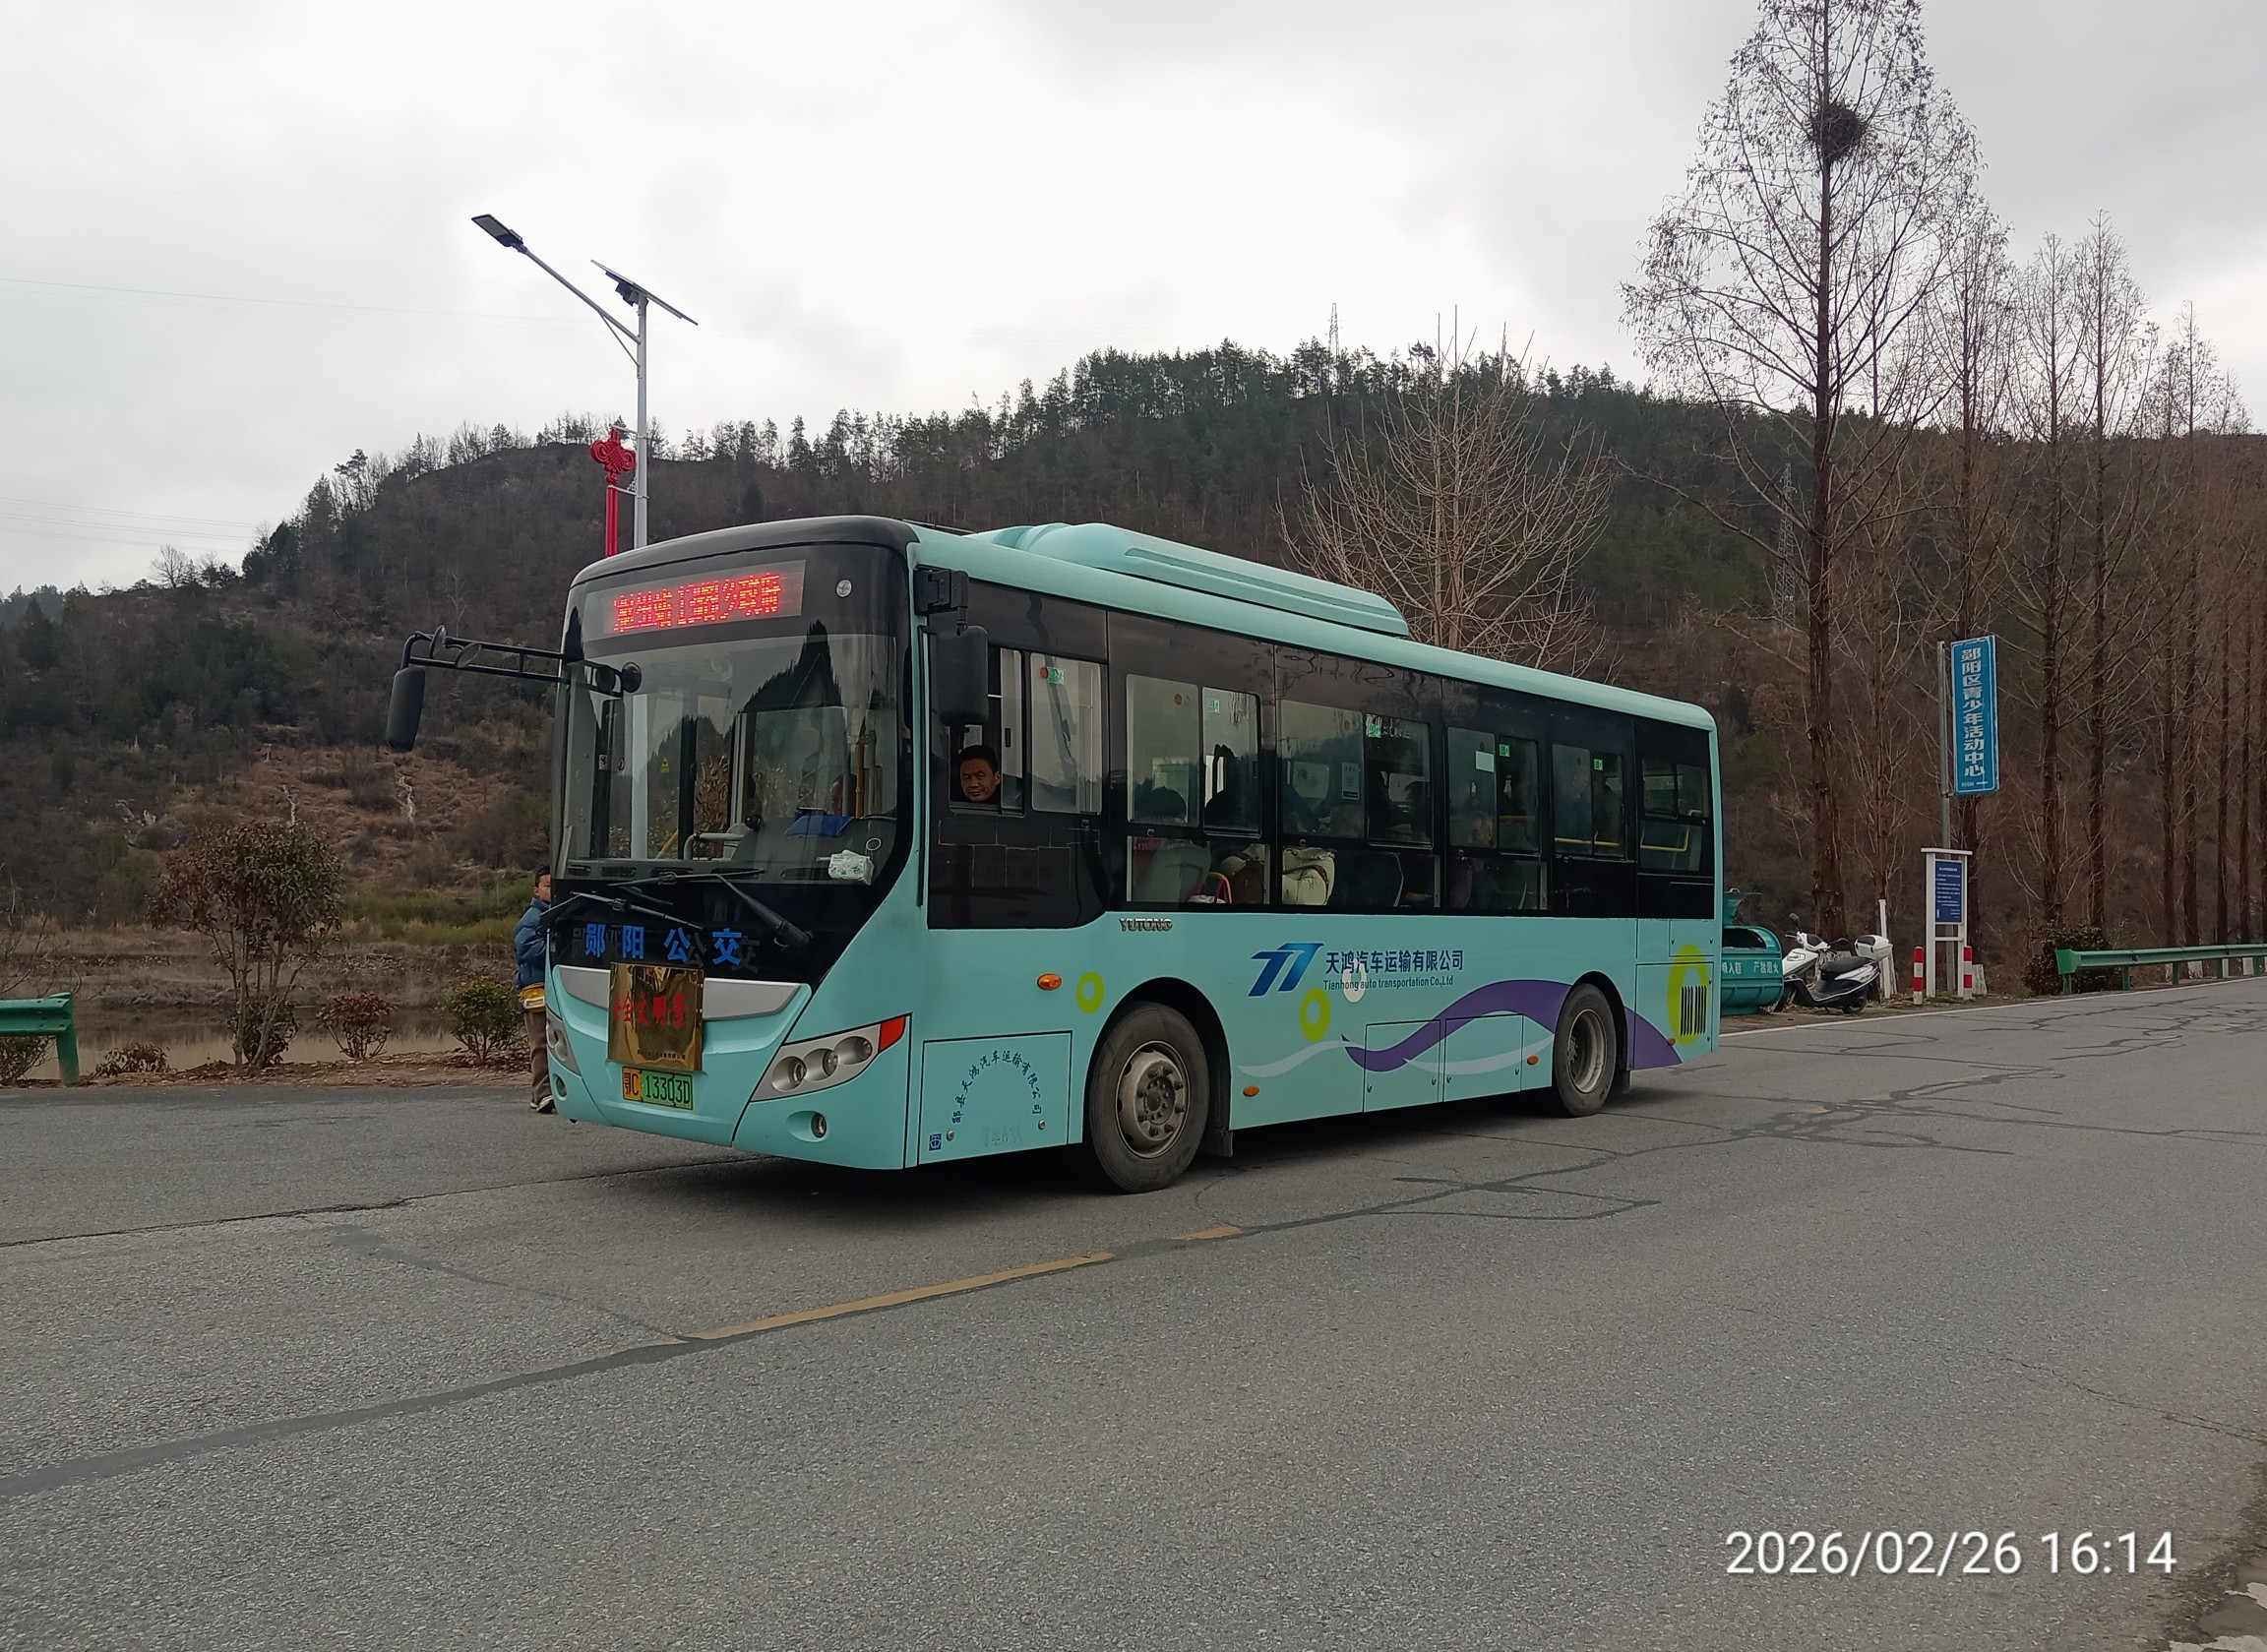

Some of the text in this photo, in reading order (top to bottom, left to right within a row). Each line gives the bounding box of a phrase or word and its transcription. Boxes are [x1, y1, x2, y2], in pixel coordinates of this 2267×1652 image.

[1961, 646, 1985, 777] 郧阳区青少年活动中心
[1119, 917, 1174, 932] YUTONG
[585, 923, 743, 965] 郧阳公交
[1325, 949, 1464, 975] 天鸿汽车运输有限公司
[1323, 979, 1359, 992] Tianhong
[1360, 978, 1378, 990] auto
[1378, 975, 1430, 990] transportation
